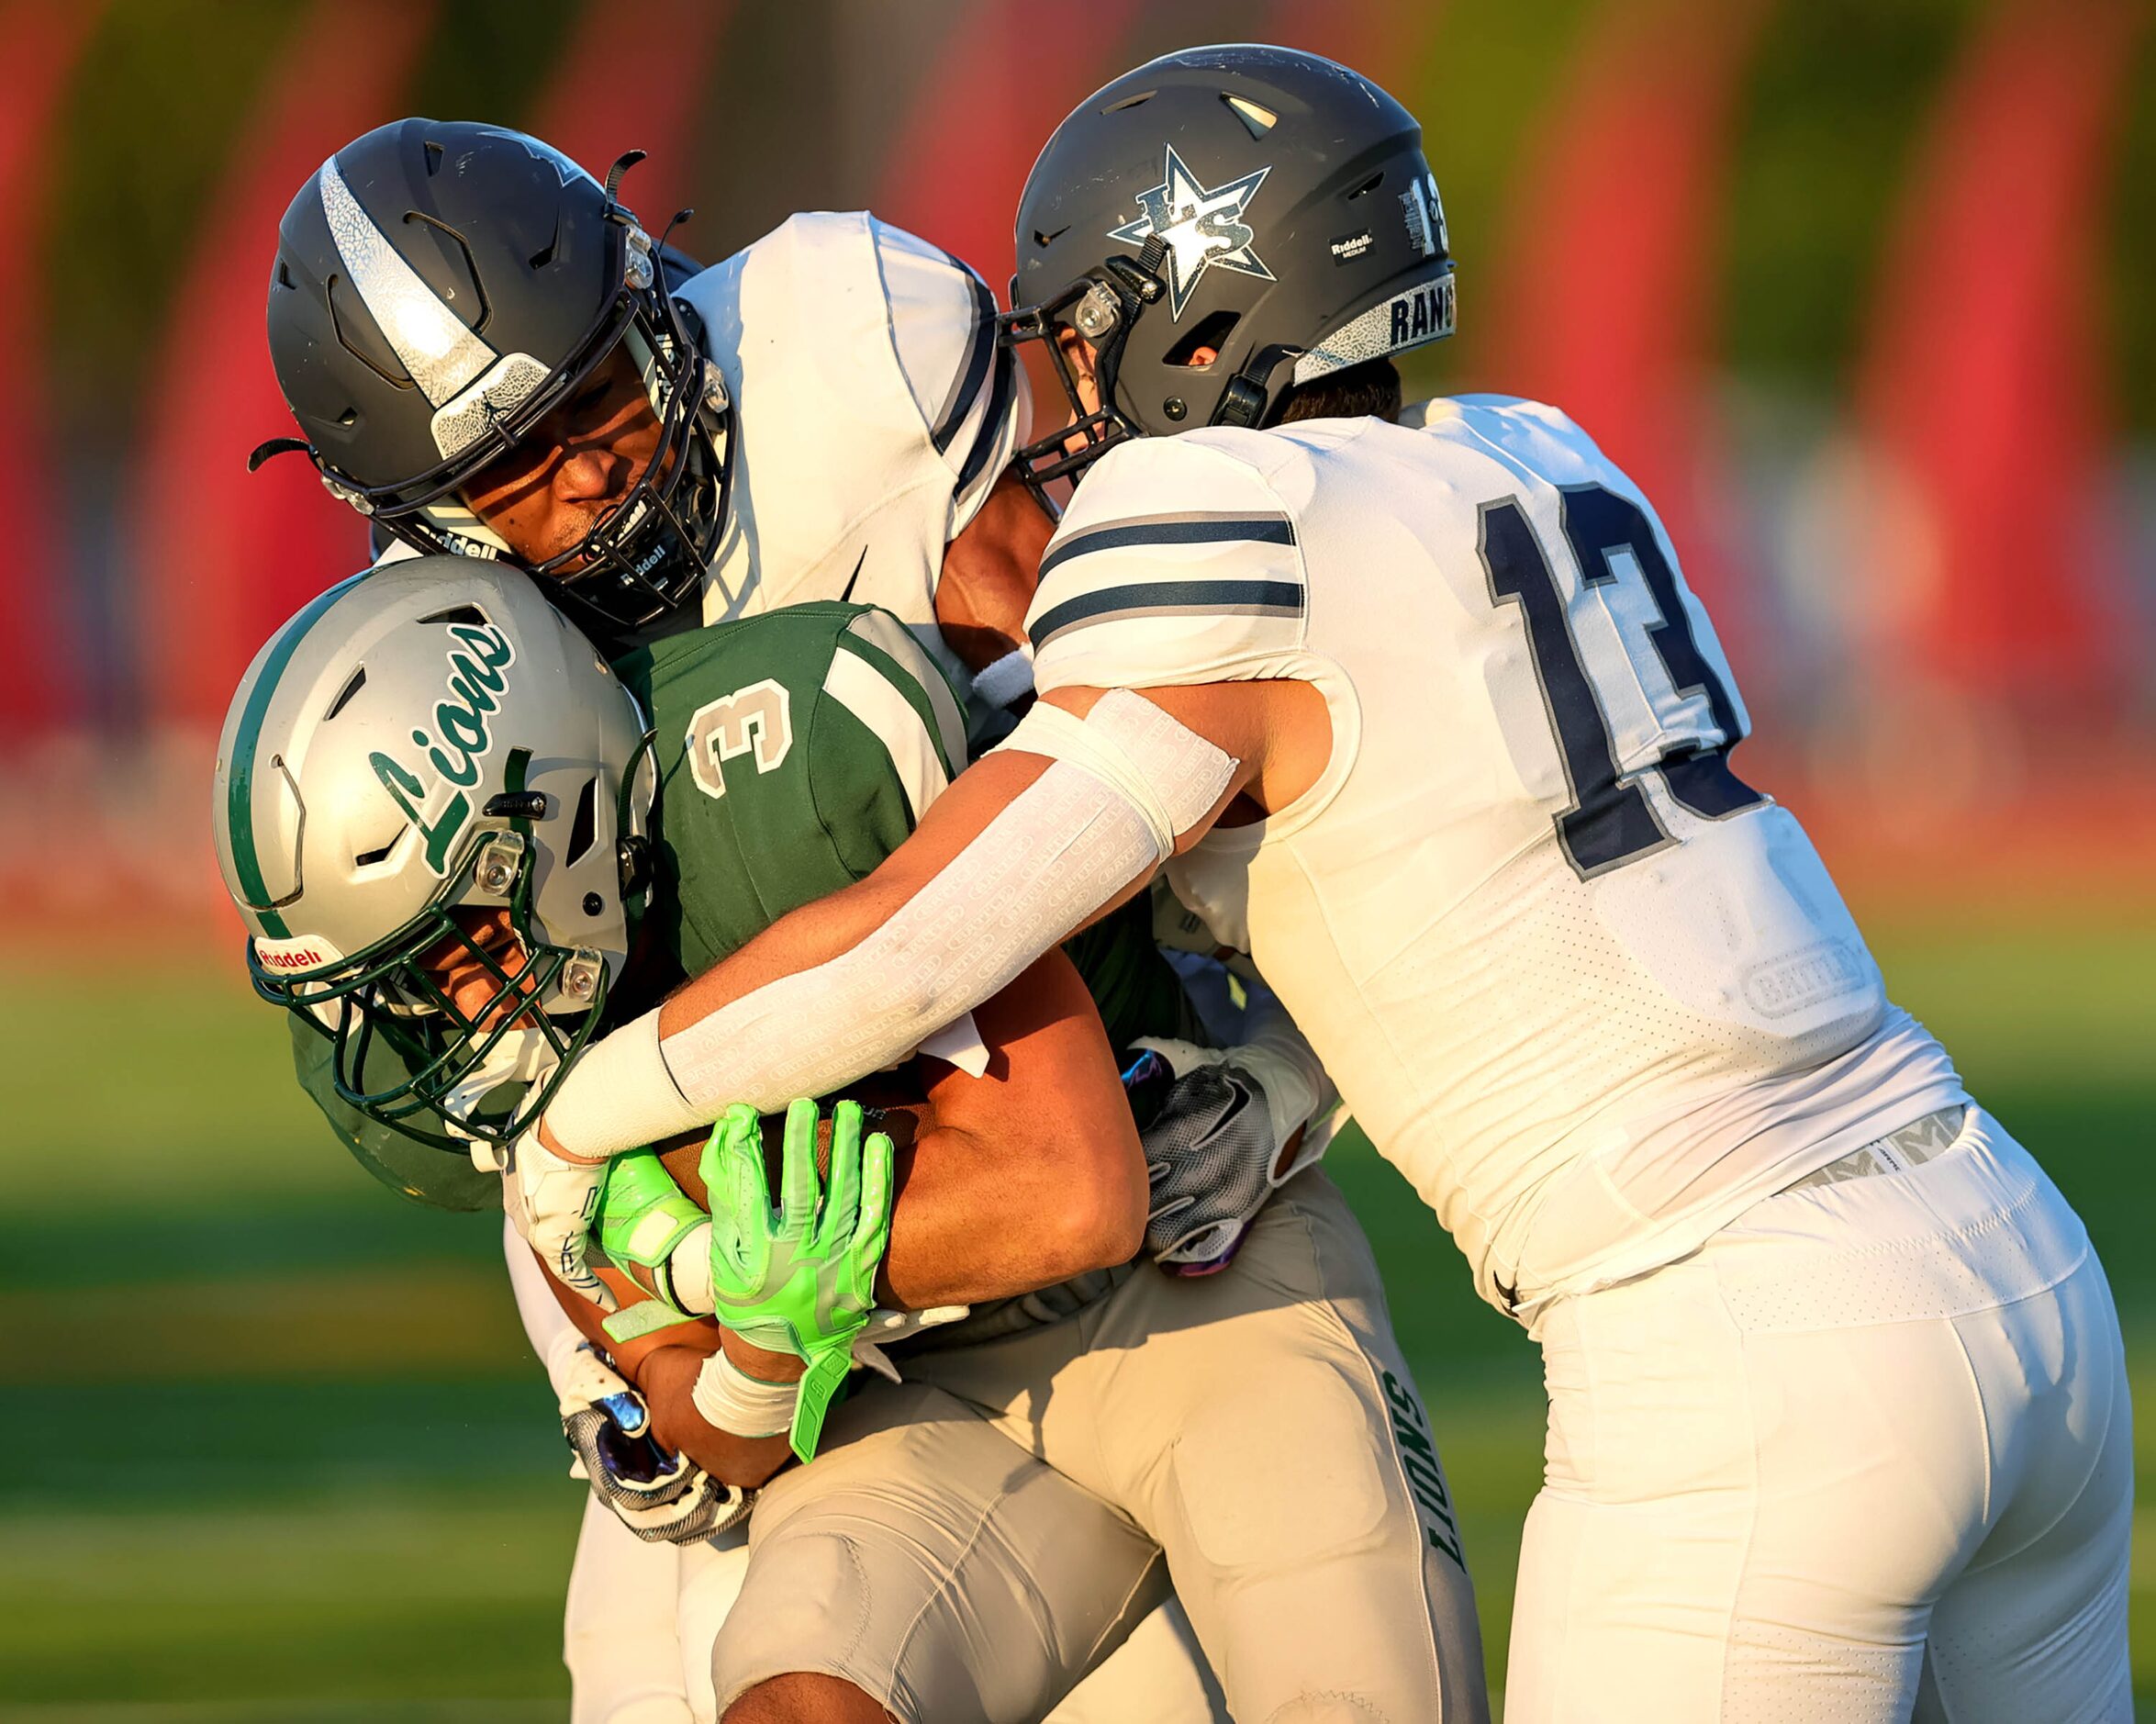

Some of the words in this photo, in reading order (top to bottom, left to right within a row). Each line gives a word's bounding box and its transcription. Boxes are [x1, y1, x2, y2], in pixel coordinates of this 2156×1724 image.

[1331, 233, 1373, 256] Riddell
[367, 621, 517, 879] Lions
[687, 677, 793, 799] 3
[1475, 479, 1776, 883] 13
[1382, 1371, 1467, 1575] LIONS
